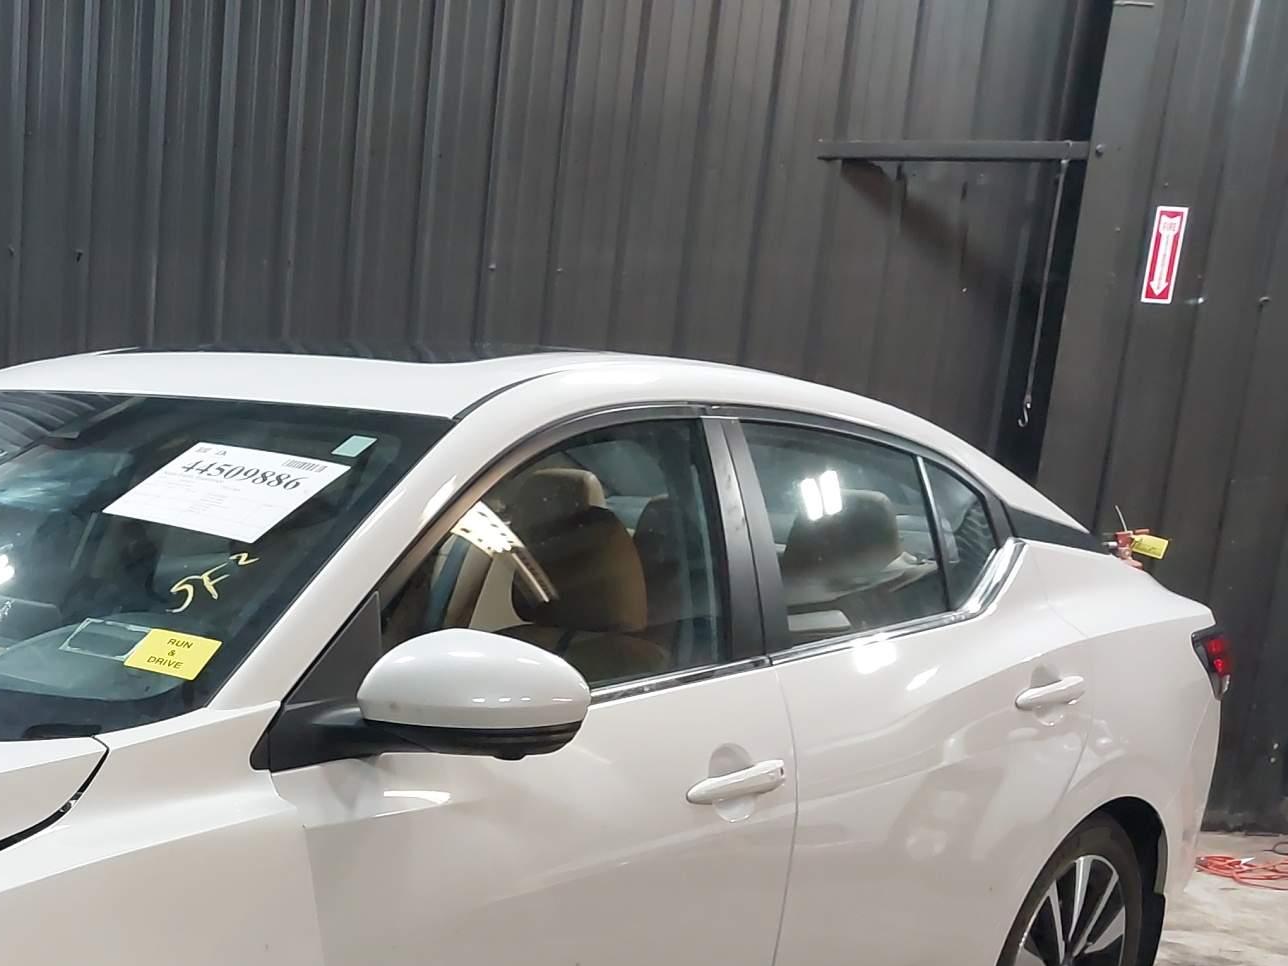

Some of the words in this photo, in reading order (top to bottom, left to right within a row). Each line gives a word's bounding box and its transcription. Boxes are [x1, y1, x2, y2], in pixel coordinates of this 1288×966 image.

[181, 459, 308, 490] 44509886
[167, 638, 194, 649] RUN
[167, 649, 176, 657] &
[146, 655, 184, 670] DRIVE
